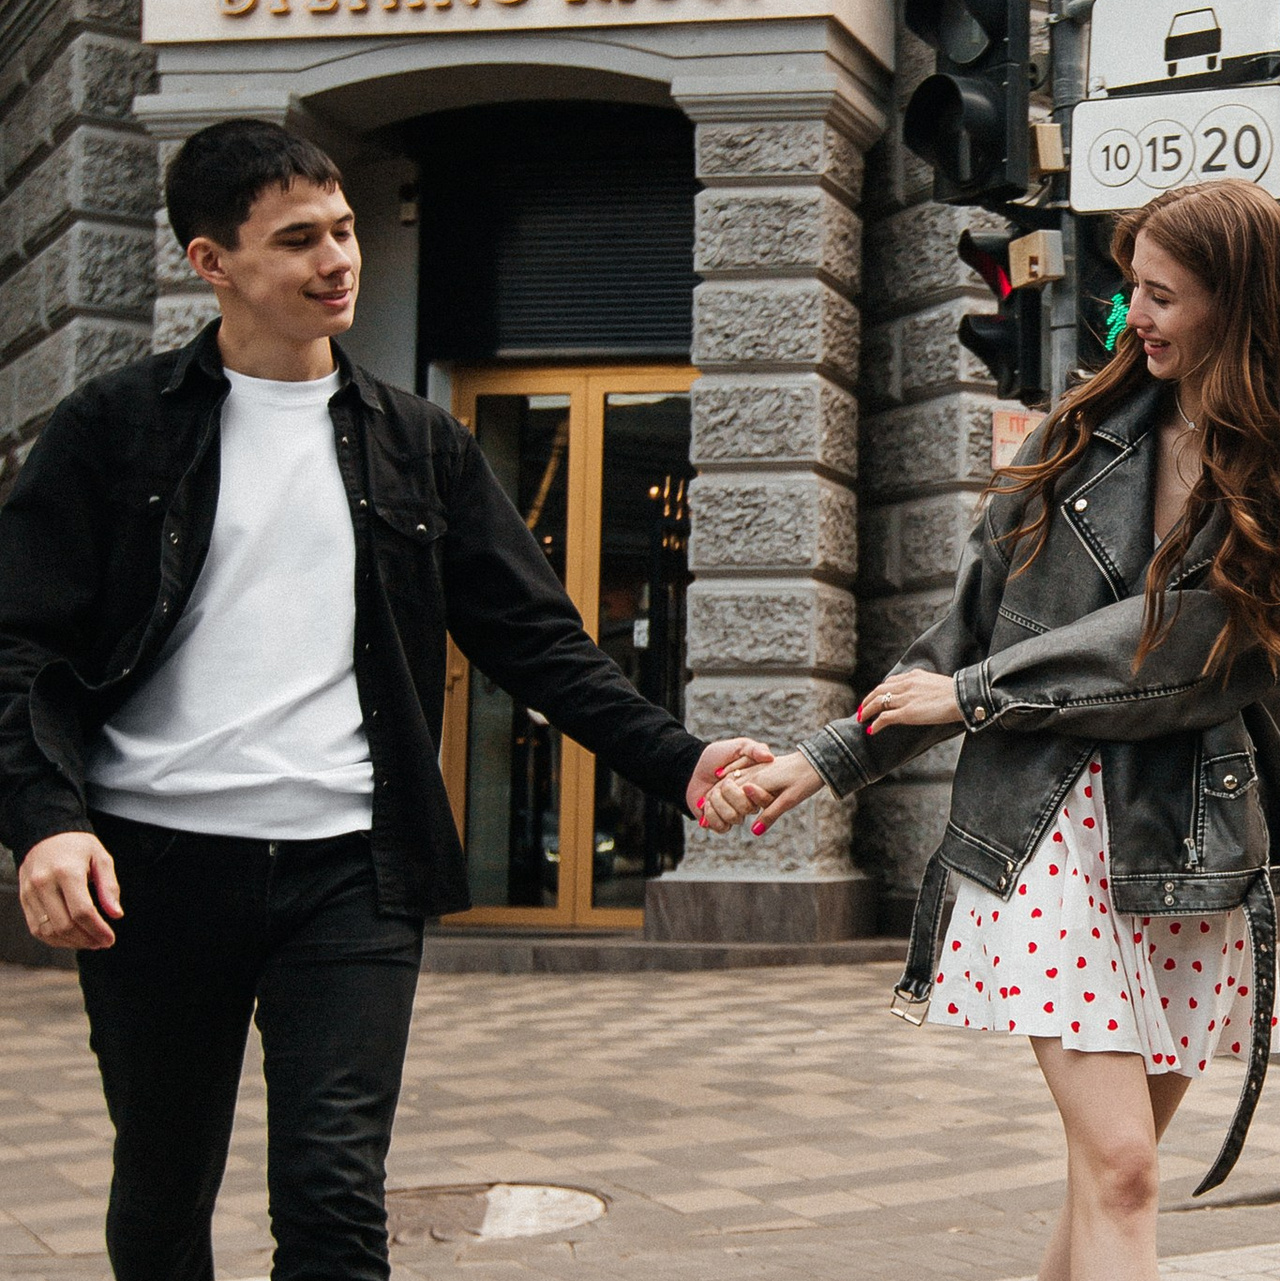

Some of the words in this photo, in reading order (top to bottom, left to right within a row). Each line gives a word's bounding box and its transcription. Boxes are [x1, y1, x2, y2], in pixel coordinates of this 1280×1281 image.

[1101, 143, 1131, 172] 10
[1145, 134, 1183, 173] 15
[1200, 124, 1262, 173] 20
